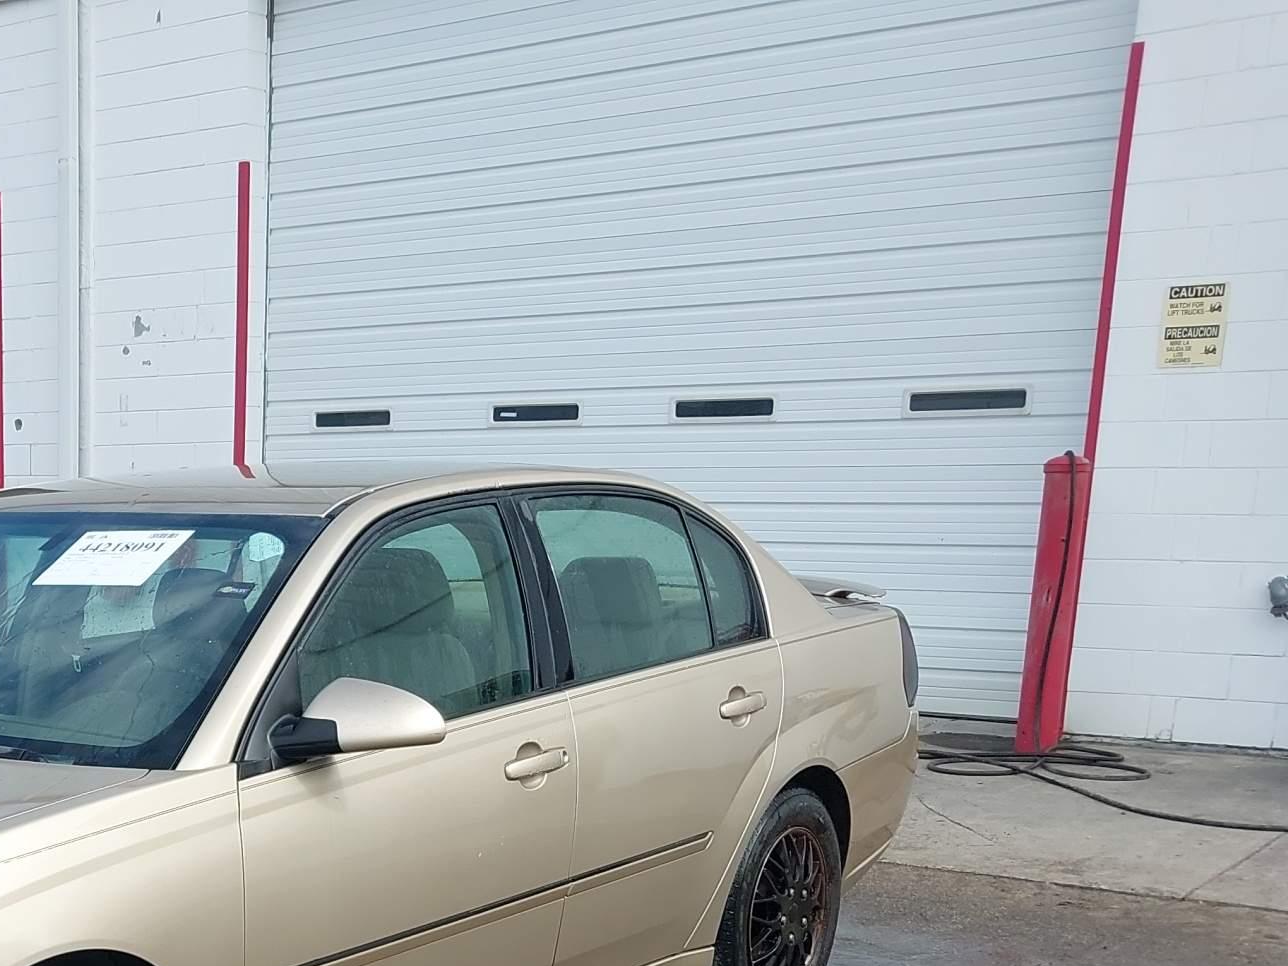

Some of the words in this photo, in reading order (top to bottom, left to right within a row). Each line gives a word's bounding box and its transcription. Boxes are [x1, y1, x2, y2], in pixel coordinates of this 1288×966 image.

[1171, 285, 1224, 298] CAUTION
[1166, 326, 1219, 339] PRECAUCION
[78, 541, 166, 553] 44218091
